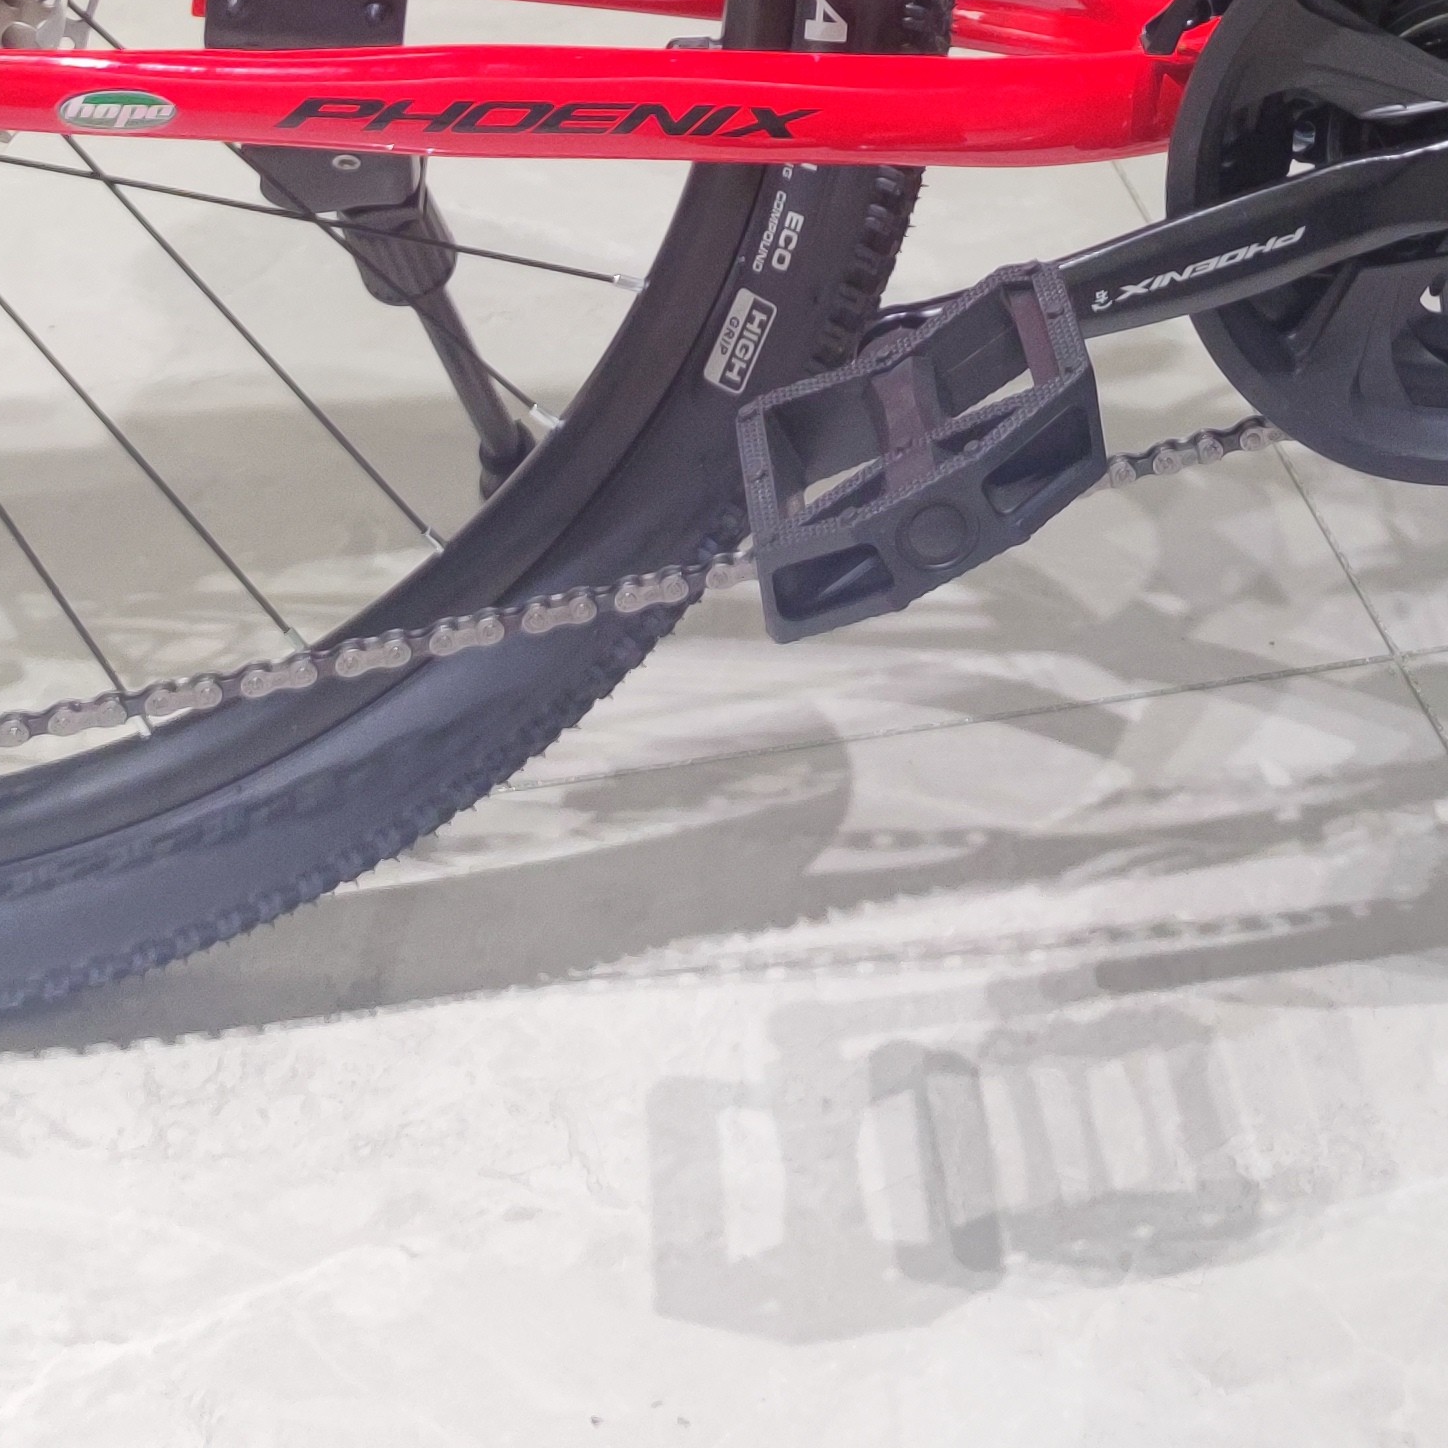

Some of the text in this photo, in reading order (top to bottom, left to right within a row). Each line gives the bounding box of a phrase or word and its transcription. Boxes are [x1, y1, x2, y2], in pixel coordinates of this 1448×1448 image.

[62, 93, 175, 128] hope
[273, 96, 827, 140] PHOENIX
[752, 190, 787, 273] COMPOUND
[771, 211, 804, 271] ECO
[1115, 225, 1306, 302] PHOENIX
[720, 316, 741, 356] GRIP
[725, 309, 767, 384] HIGH
